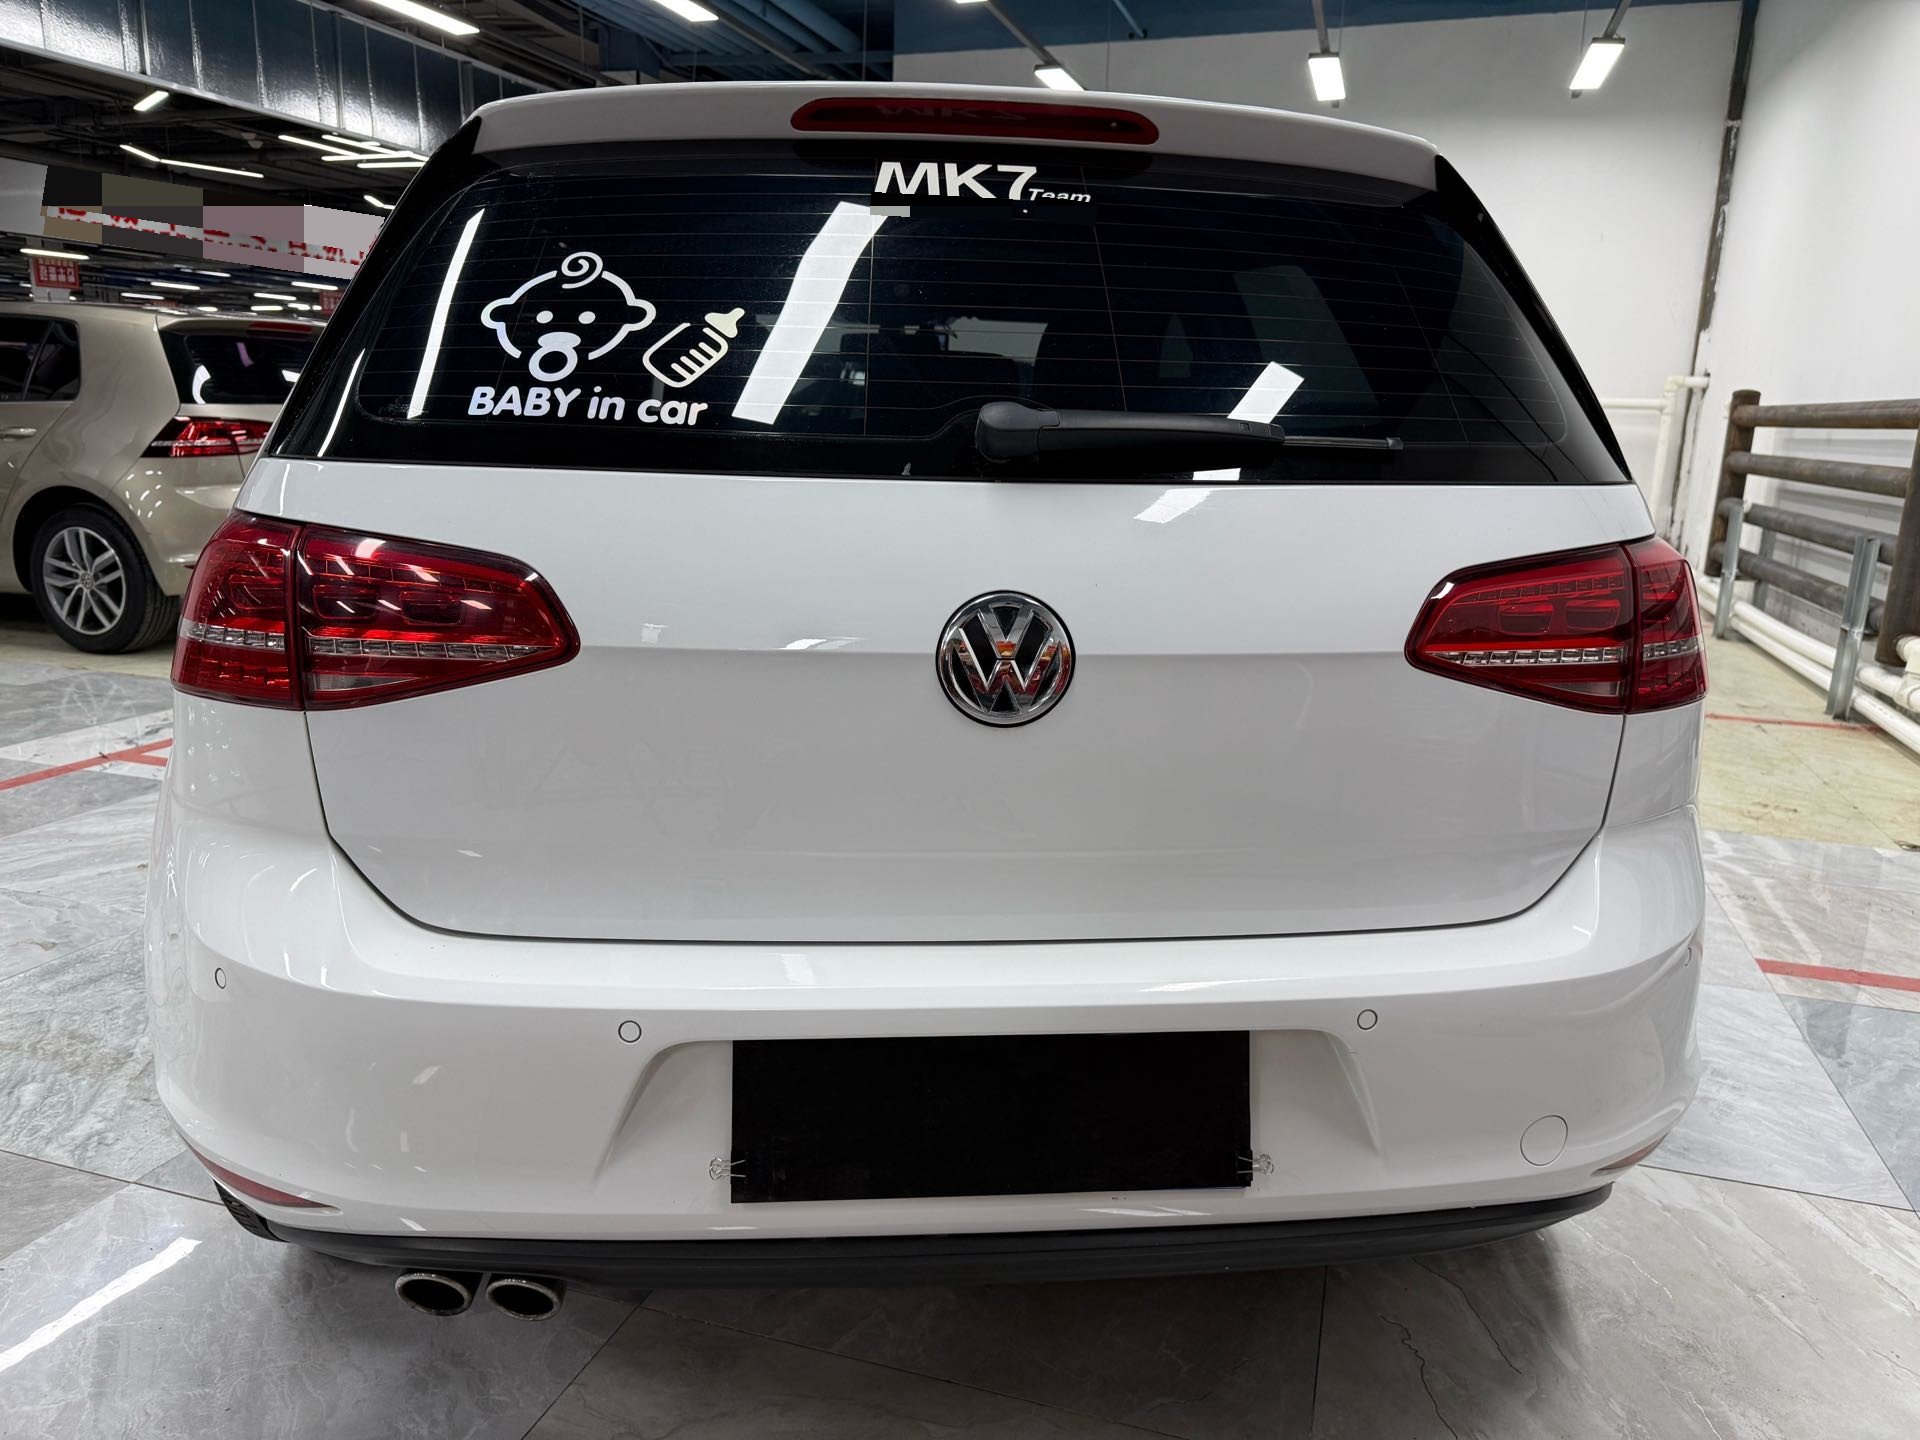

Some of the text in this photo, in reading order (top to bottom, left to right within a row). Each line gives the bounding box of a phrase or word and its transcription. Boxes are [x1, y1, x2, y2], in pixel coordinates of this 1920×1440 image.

[874, 161, 1092, 203] MK7 Team
[467, 385, 709, 426] BABY in car
